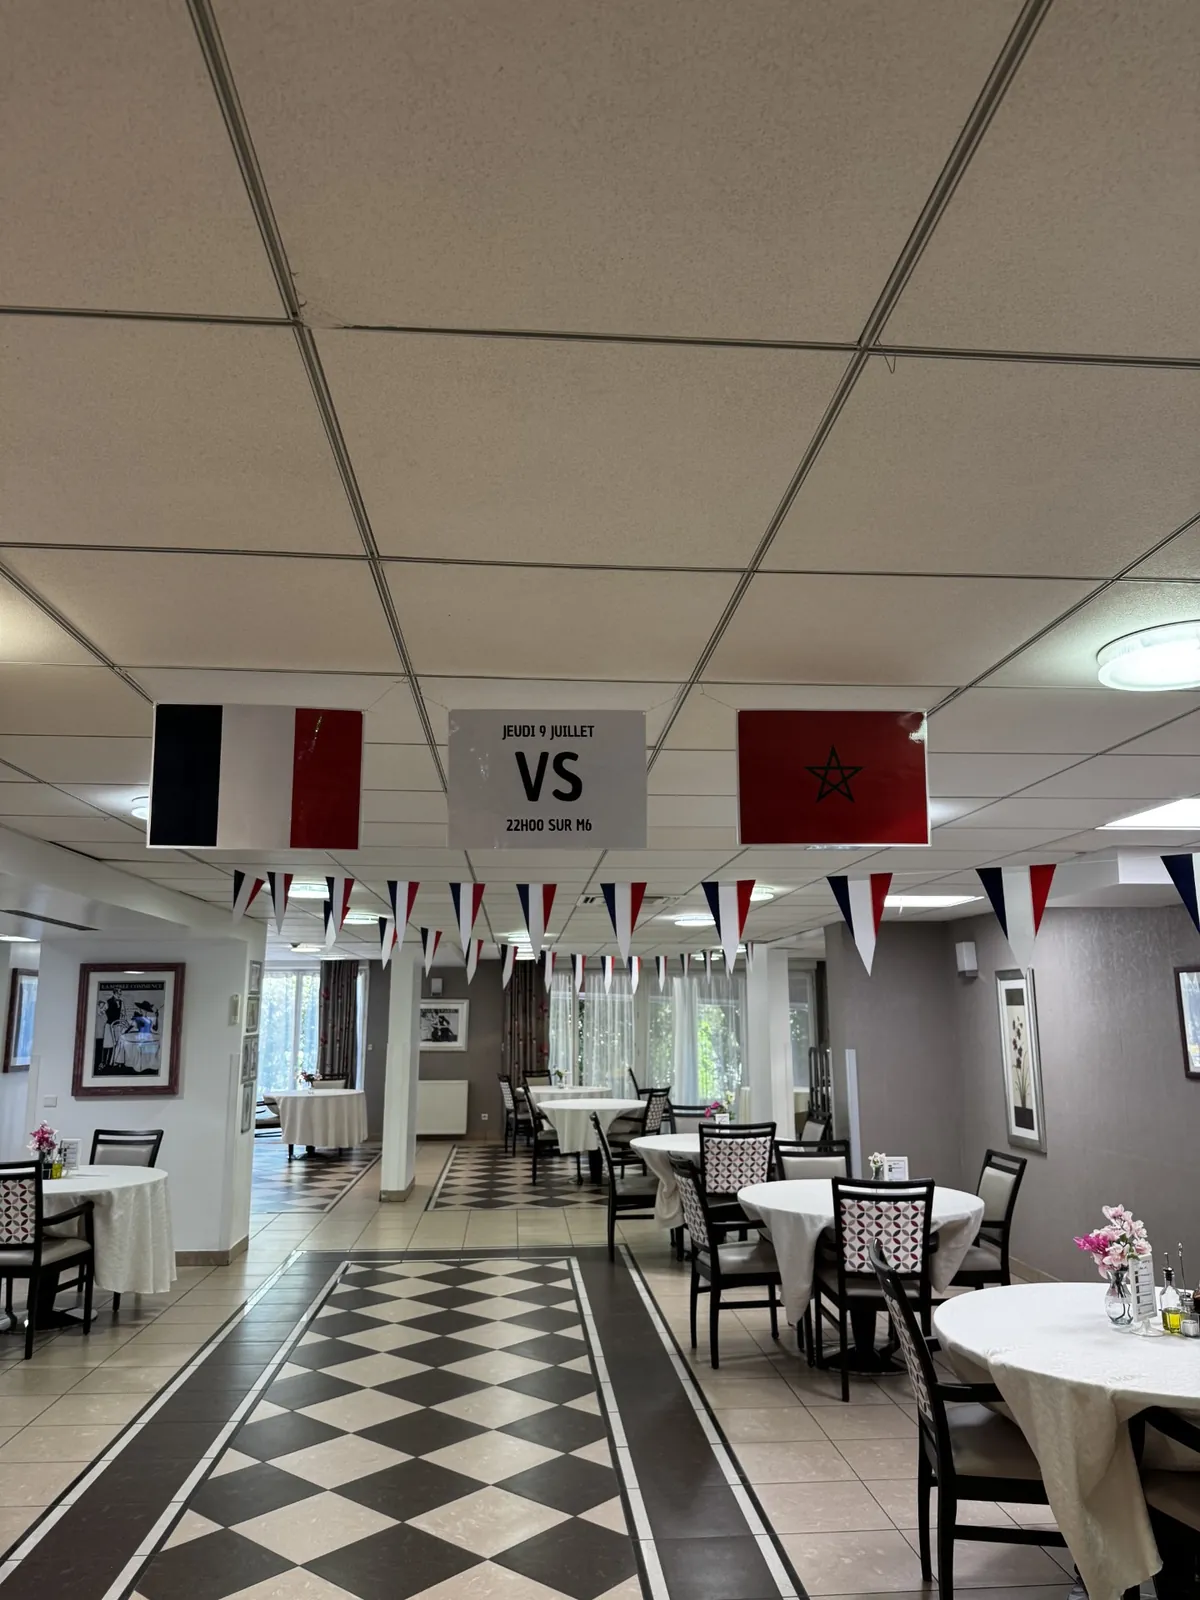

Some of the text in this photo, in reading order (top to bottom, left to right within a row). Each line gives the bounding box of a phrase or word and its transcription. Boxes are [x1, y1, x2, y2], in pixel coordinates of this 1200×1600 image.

[502, 725, 595, 740] JEUDI 9 JUILLET
[515, 751, 583, 802] VS
[506, 819, 592, 832] 22H00 SUR M6
